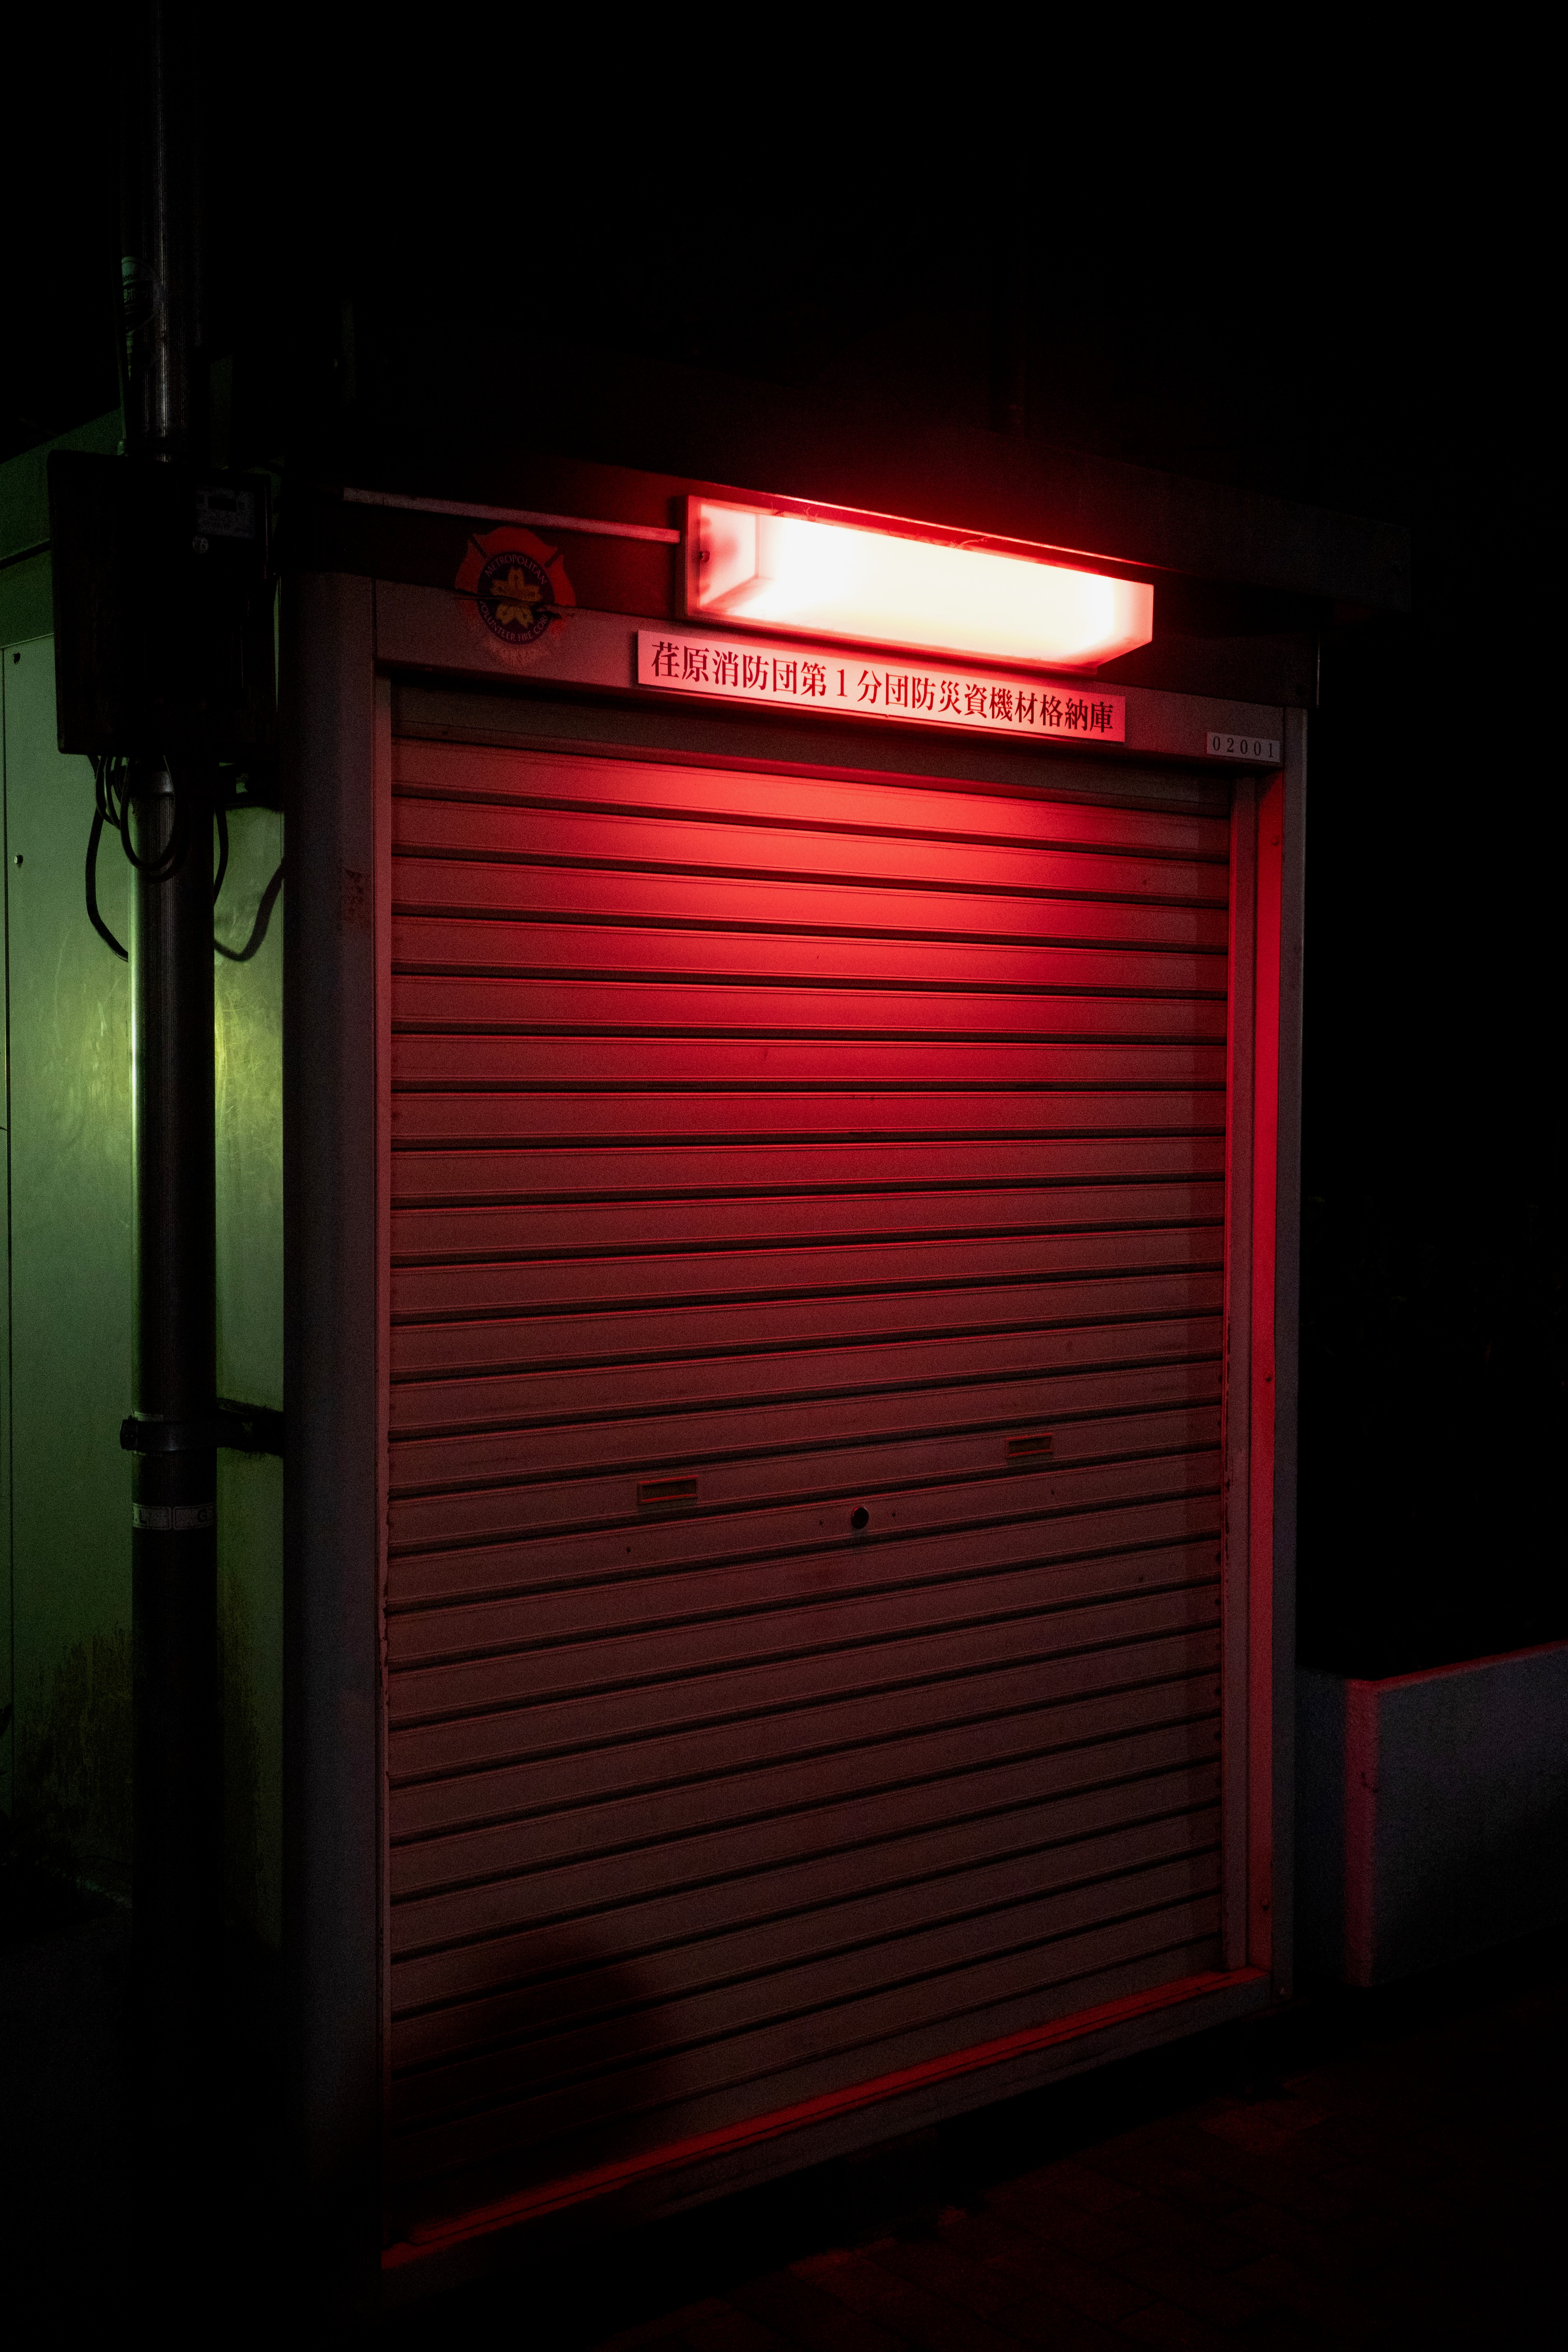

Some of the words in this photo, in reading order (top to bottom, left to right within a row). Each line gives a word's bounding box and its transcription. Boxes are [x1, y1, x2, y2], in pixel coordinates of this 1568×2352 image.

[484, 554, 548, 585] METROPOLITAN
[518, 630, 533, 642] FIRE
[651, 641, 1114, 733] 荏原消防団第1分団防災資機材格納庫
[1213, 736, 1273, 758] 02001
